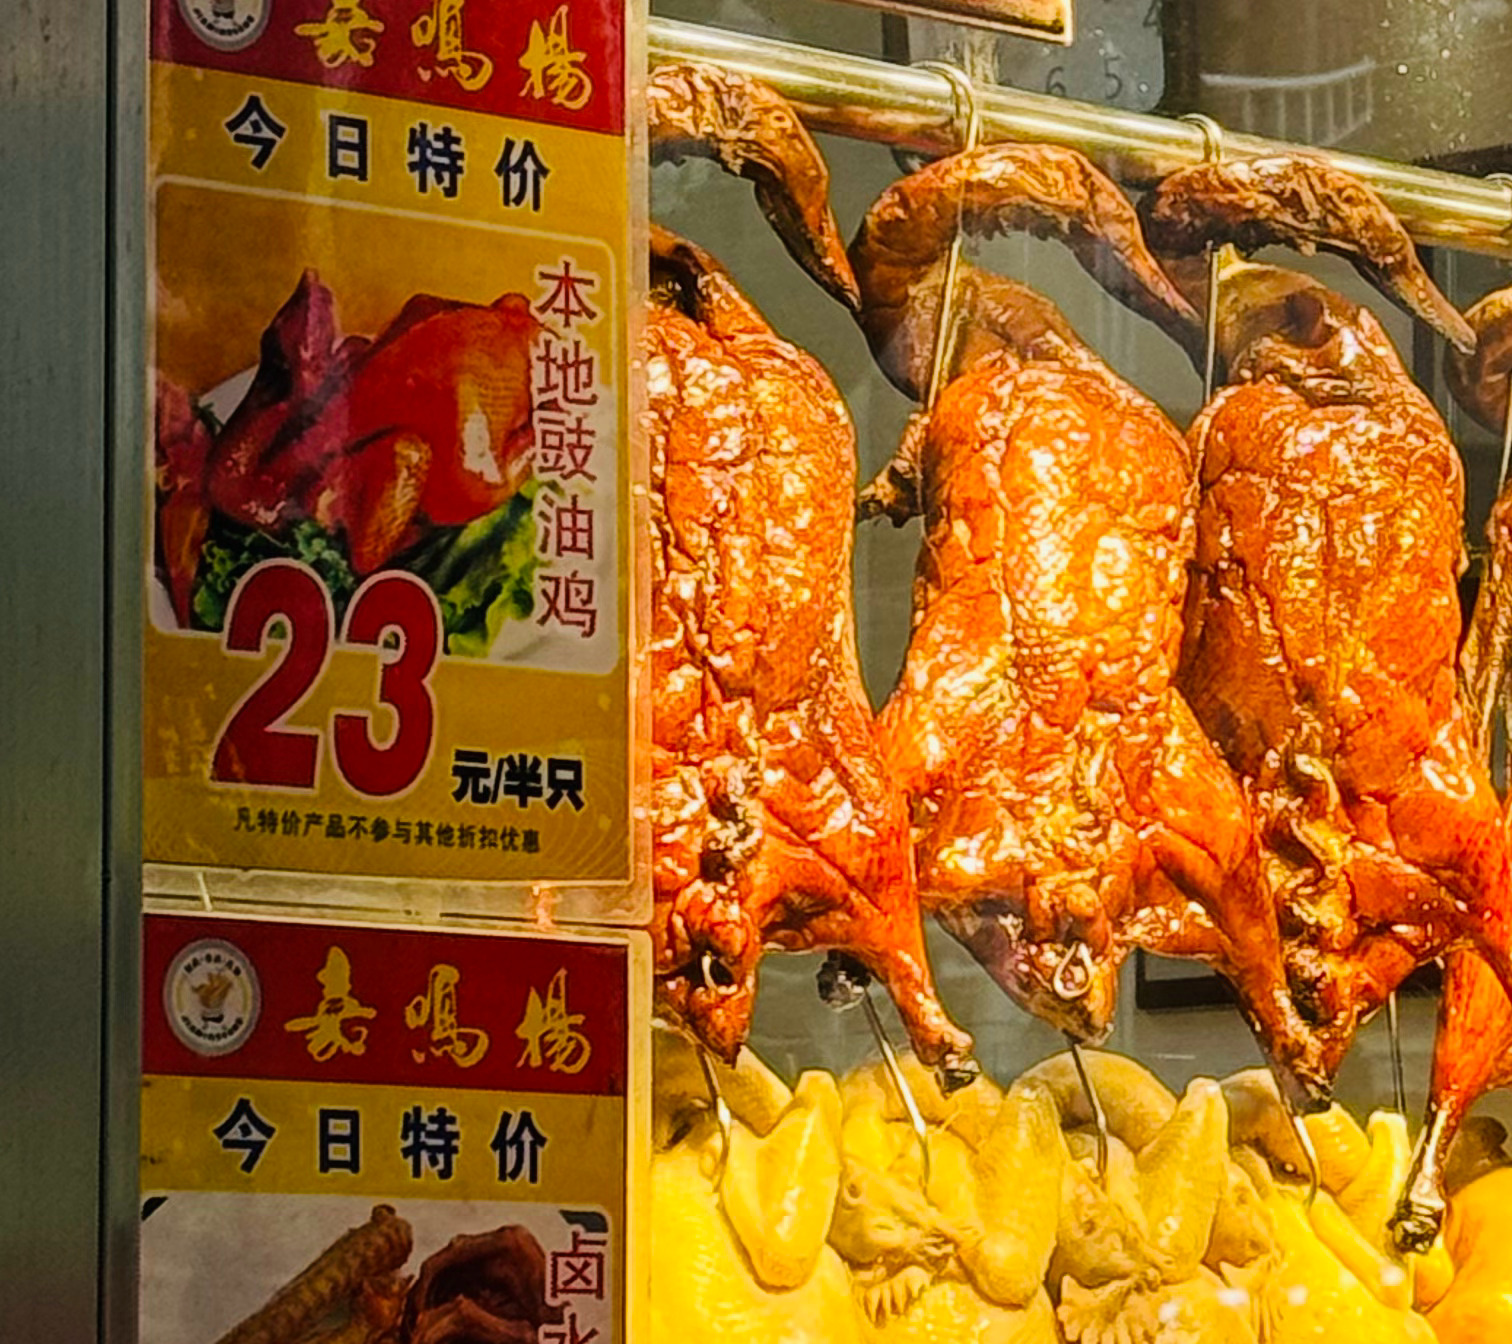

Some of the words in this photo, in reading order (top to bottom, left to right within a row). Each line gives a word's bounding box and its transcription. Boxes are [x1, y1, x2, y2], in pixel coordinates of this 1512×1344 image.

[224, 94, 551, 212] 今日特价
[534, 259, 599, 639] 本地豉油鸡
[209, 560, 441, 798] 23
[233, 807, 541, 853] 凡特价产品不参与其他折扣优惠
[451, 750, 586, 812] 元/半只
[213, 1097, 549, 1185] 今日特价
